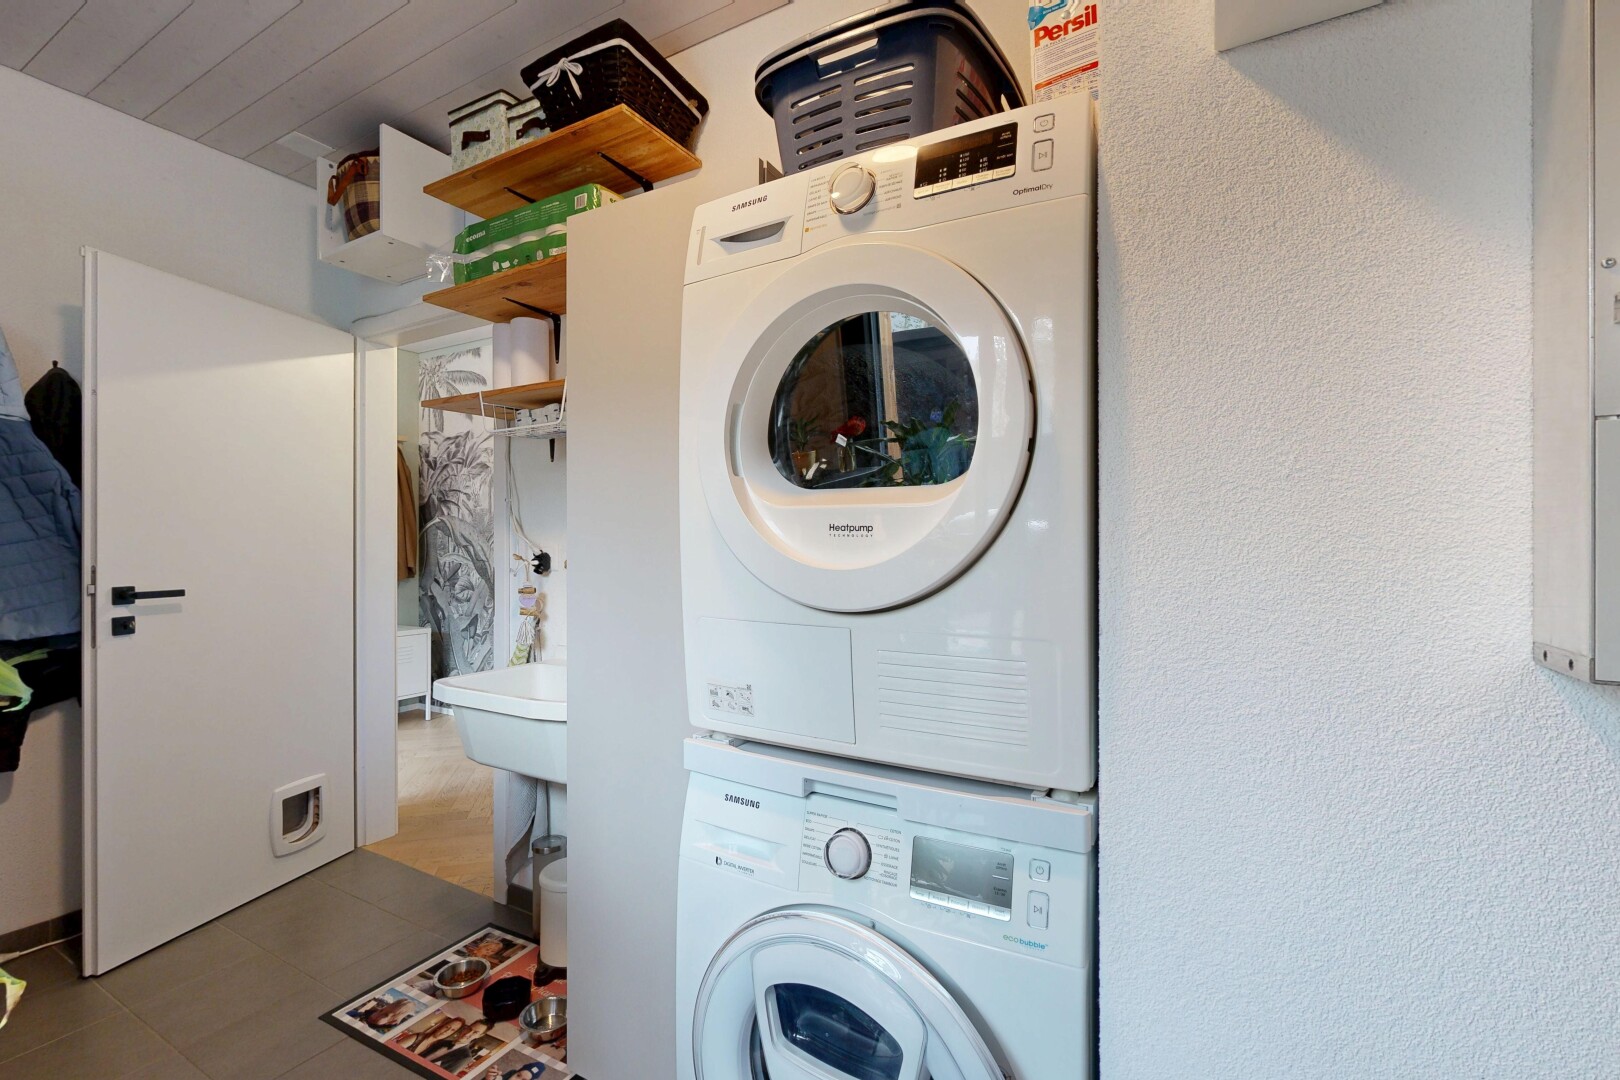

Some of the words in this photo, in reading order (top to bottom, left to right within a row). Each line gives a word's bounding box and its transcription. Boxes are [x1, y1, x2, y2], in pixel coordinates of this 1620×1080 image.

[1034, 4, 1097, 48] Persil
[1012, 183, 1053, 196] OptimalDry
[731, 194, 768, 212] SAMSUNG
[828, 523, 874, 534] Heatpump
[724, 793, 761, 809] SAMSUNG
